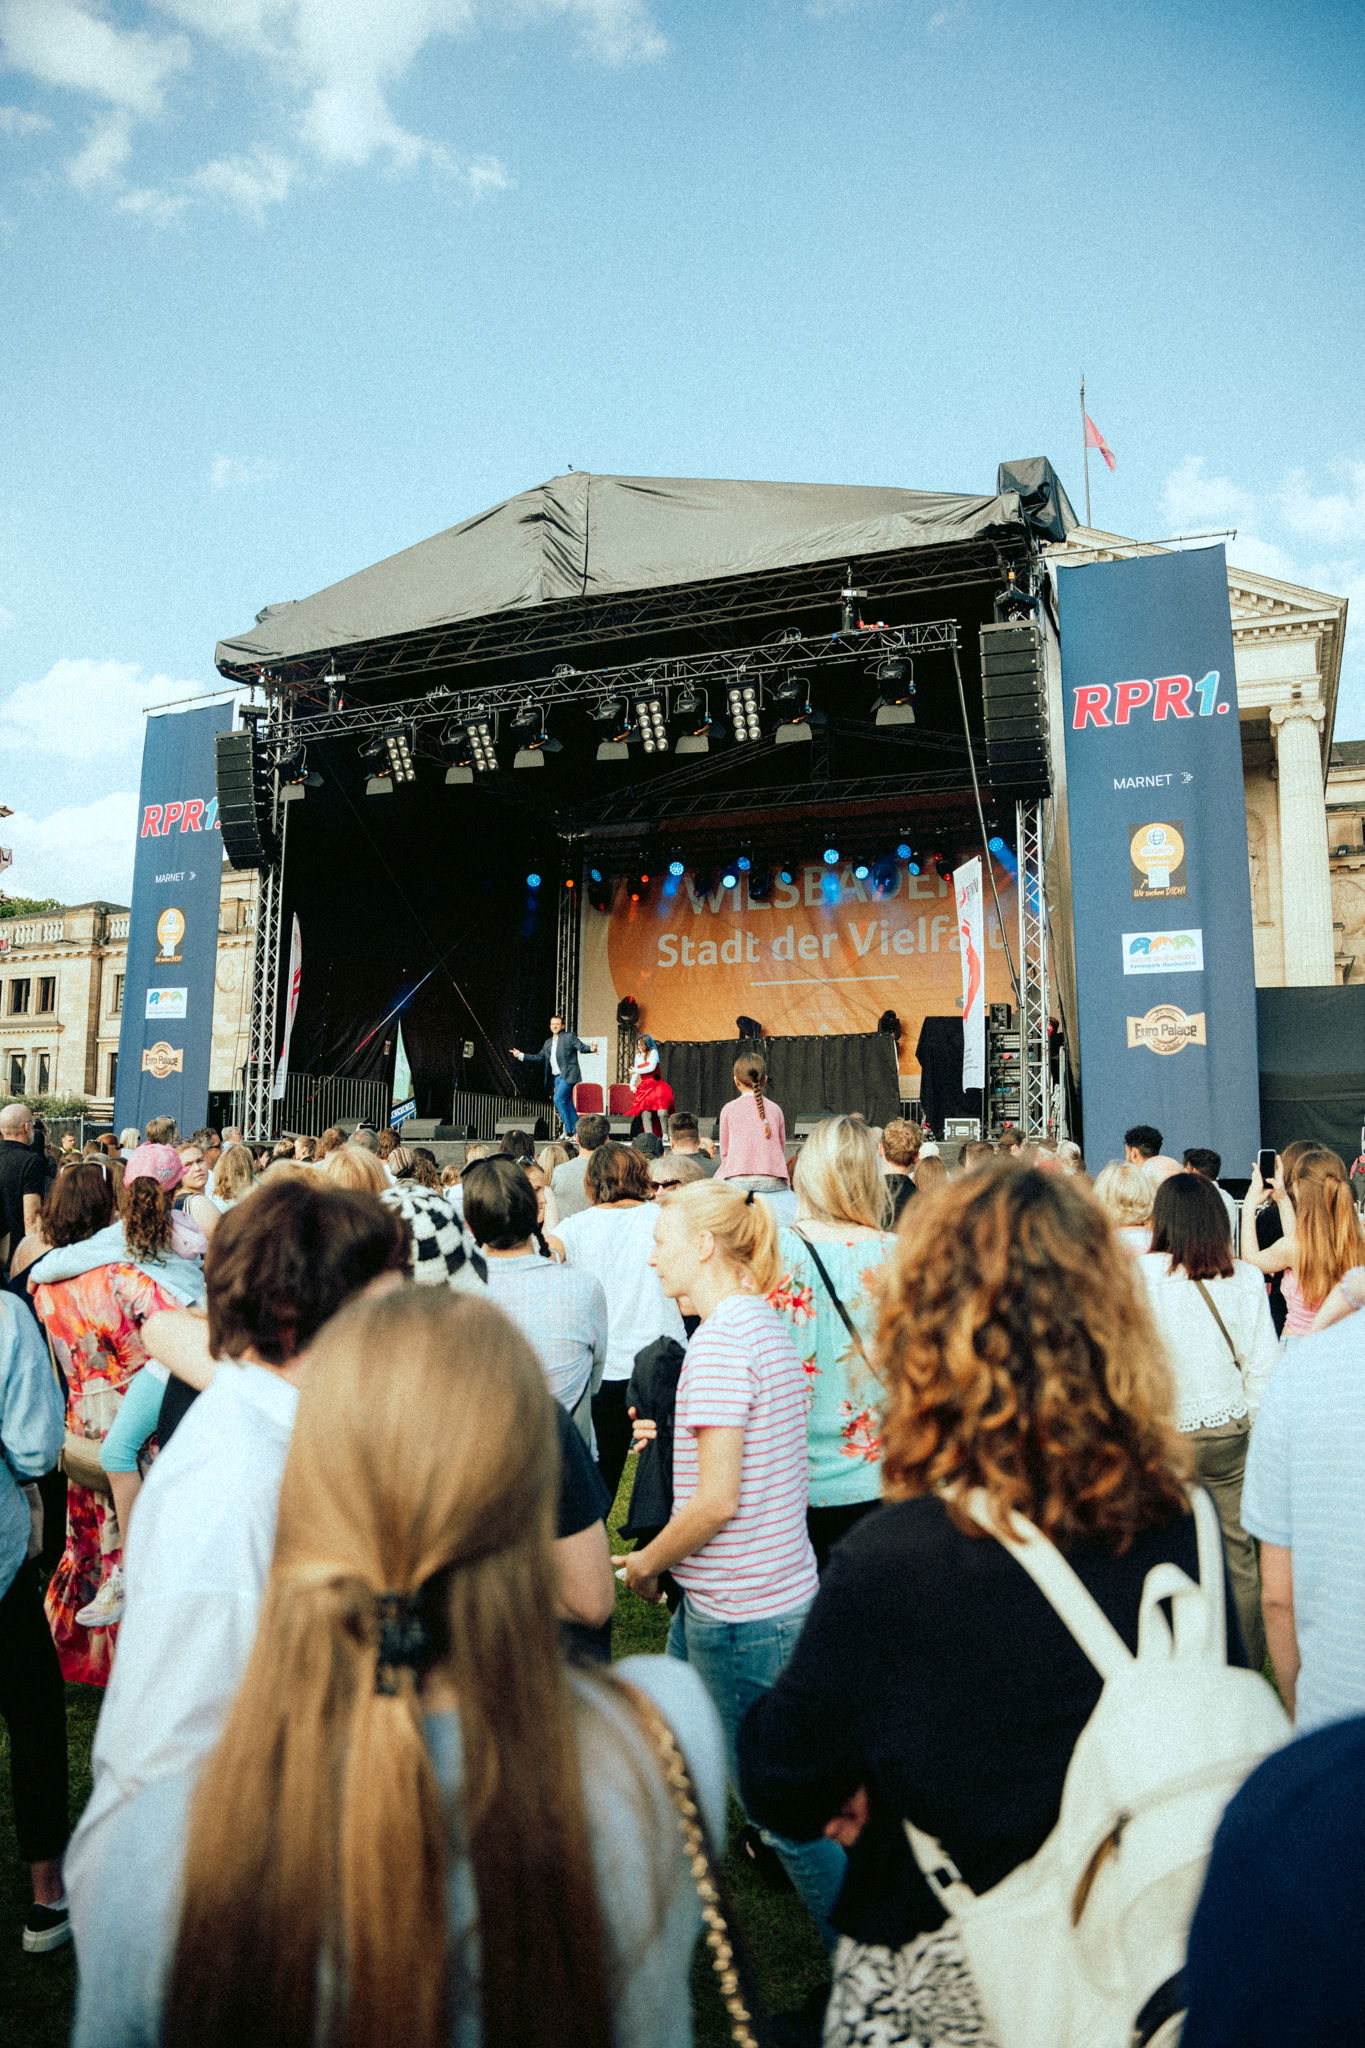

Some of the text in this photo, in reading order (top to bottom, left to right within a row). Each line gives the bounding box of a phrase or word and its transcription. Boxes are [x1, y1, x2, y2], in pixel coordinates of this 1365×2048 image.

[1072, 670, 1230, 730] RPR1.
[1113, 773, 1173, 790] MARNET
[155, 872, 185, 884] MARNET
[657, 915, 1008, 967] Stadt der Vielfat
[1134, 1022, 1198, 1039] Euro Palace
